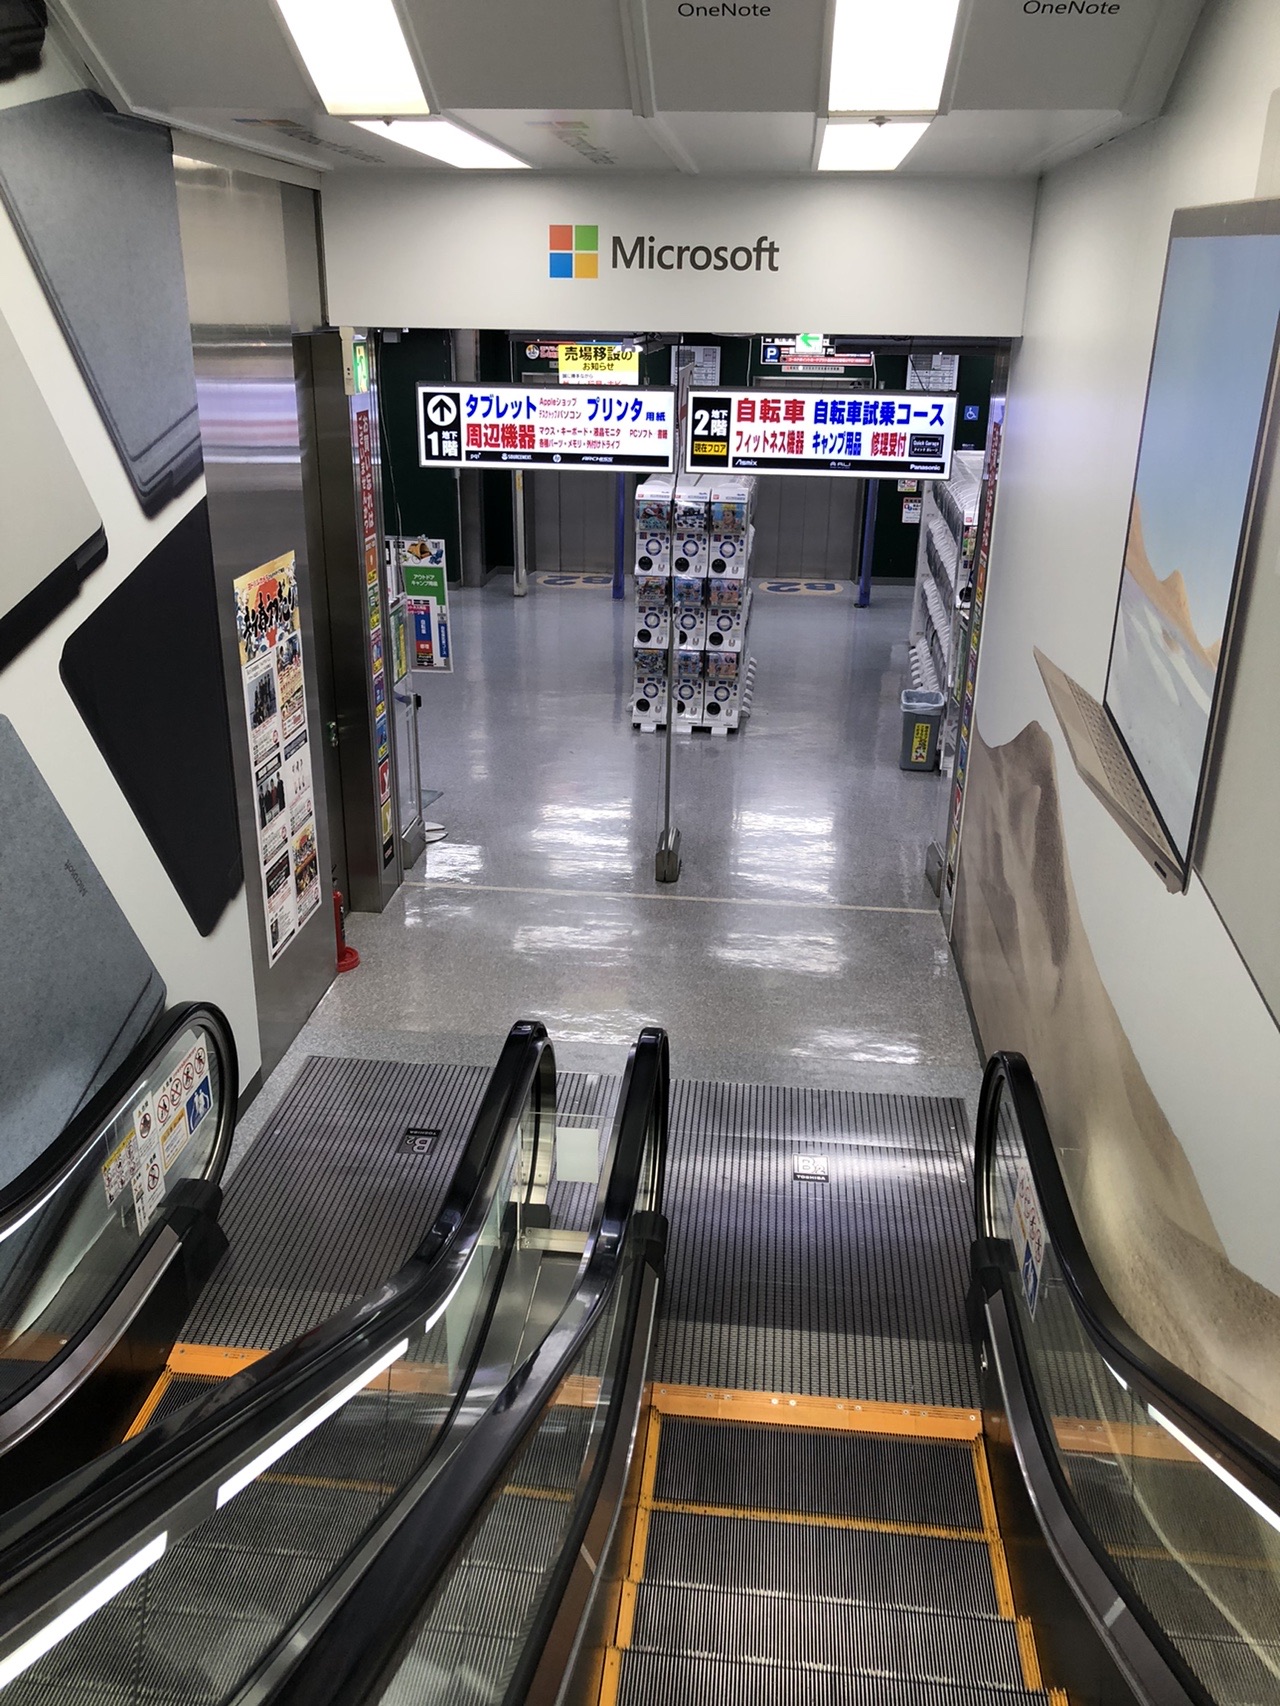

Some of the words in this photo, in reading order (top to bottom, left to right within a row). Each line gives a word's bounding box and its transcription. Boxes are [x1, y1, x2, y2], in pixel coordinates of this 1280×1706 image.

[677, 2, 772, 18] OneNote
[1022, 0, 1121, 15] OneNote
[611, 235, 780, 271] Microsoft
[564, 345, 633, 362] 売場移設の
[582, 362, 615, 371] お知らせ
[465, 393, 537, 419] タブレット
[539, 397, 577, 406] Appleショップ
[587, 396, 643, 422] プリンタ
[645, 411, 666, 422] 用紙
[711, 409, 728, 419] 地下
[736, 397, 806, 424] 自転車
[813, 400, 945, 427] 自転車試乗コース
[693, 409, 710, 436] 2
[710, 419, 728, 437] 階
[441, 430, 458, 440] 地下
[465, 423, 536, 450] 周辺機器
[629, 429, 653, 438] PCソフト
[427, 431, 439, 456] 1
[442, 440, 459, 457] 階
[694, 443, 727, 453] 現在フロア
[735, 430, 805, 455] フィットネス機器
[812, 431, 862, 457] キャンプ用品
[870, 431, 907, 457] 修理受付
[405, 1136, 433, 1154] B2
